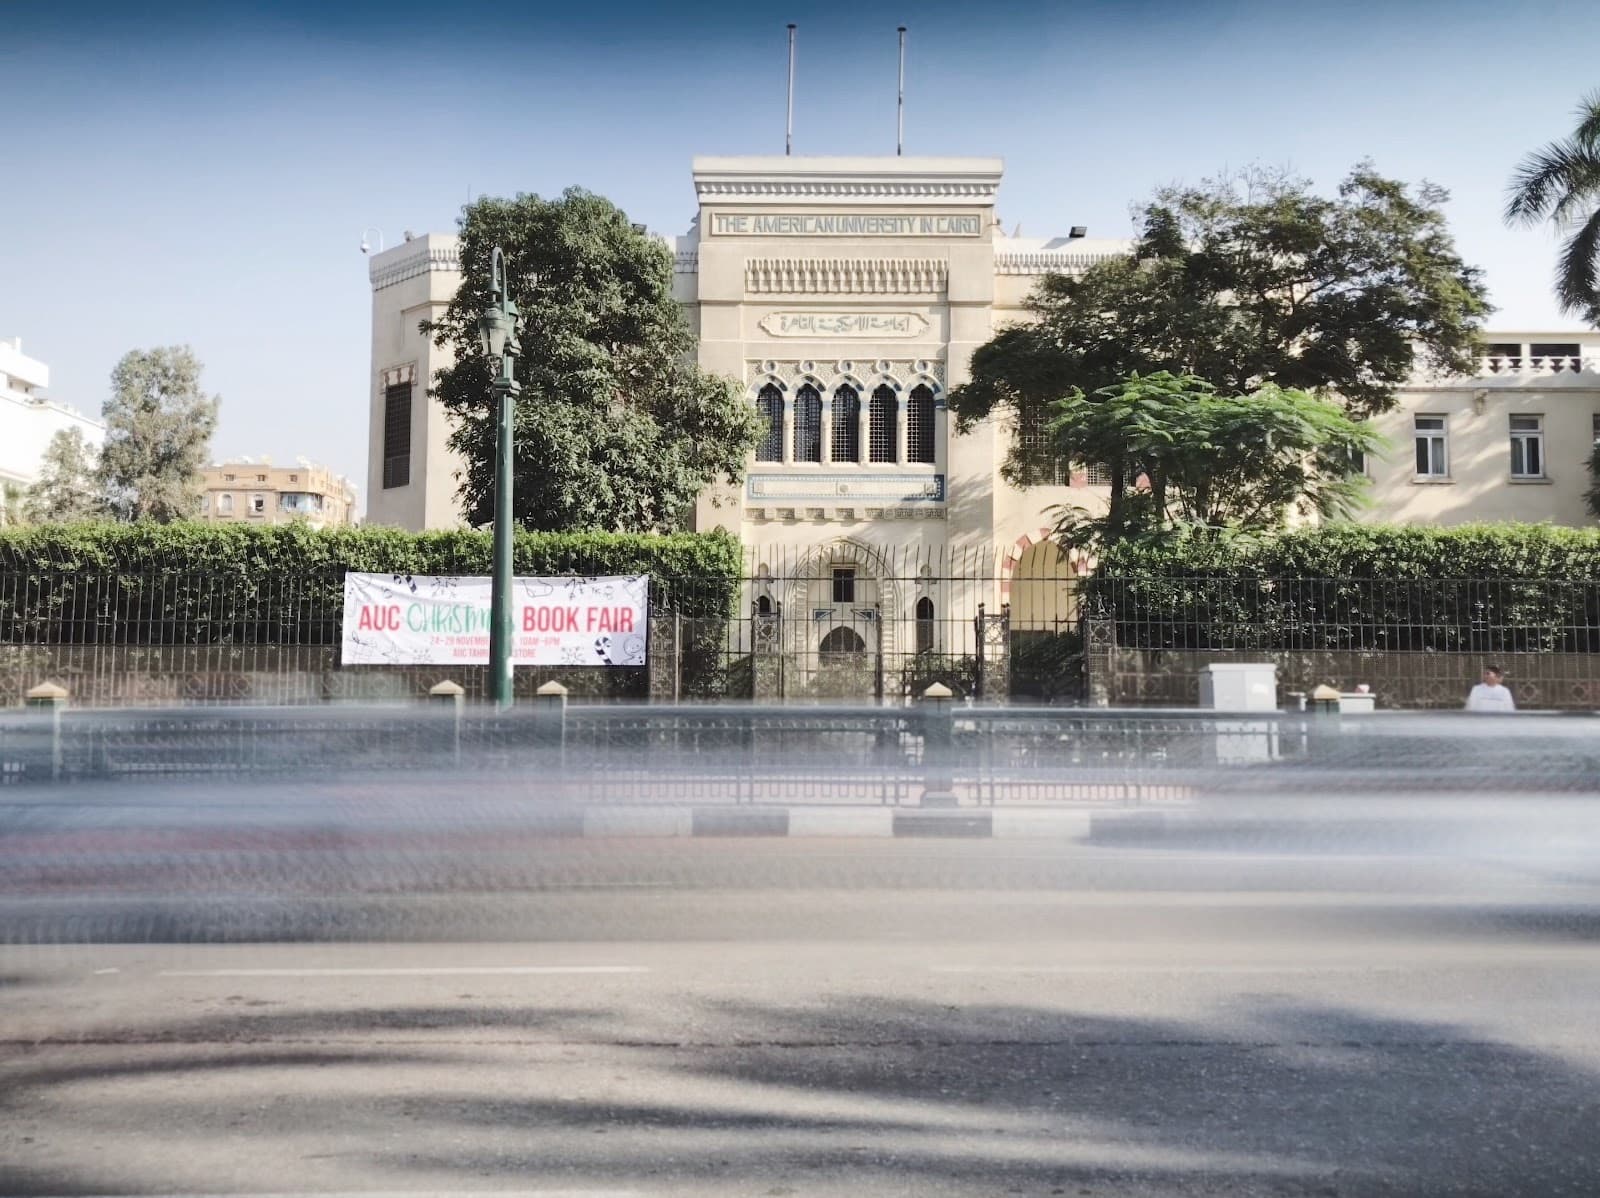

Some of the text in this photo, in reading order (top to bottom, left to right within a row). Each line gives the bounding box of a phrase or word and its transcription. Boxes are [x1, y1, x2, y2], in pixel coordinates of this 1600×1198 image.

[715, 216, 977, 233] THE AMERICAN UNIVERSITY IN CAIRO
[358, 605, 401, 631] AUC
[522, 606, 579, 632] BOOK
[587, 606, 633, 633] FAIR
